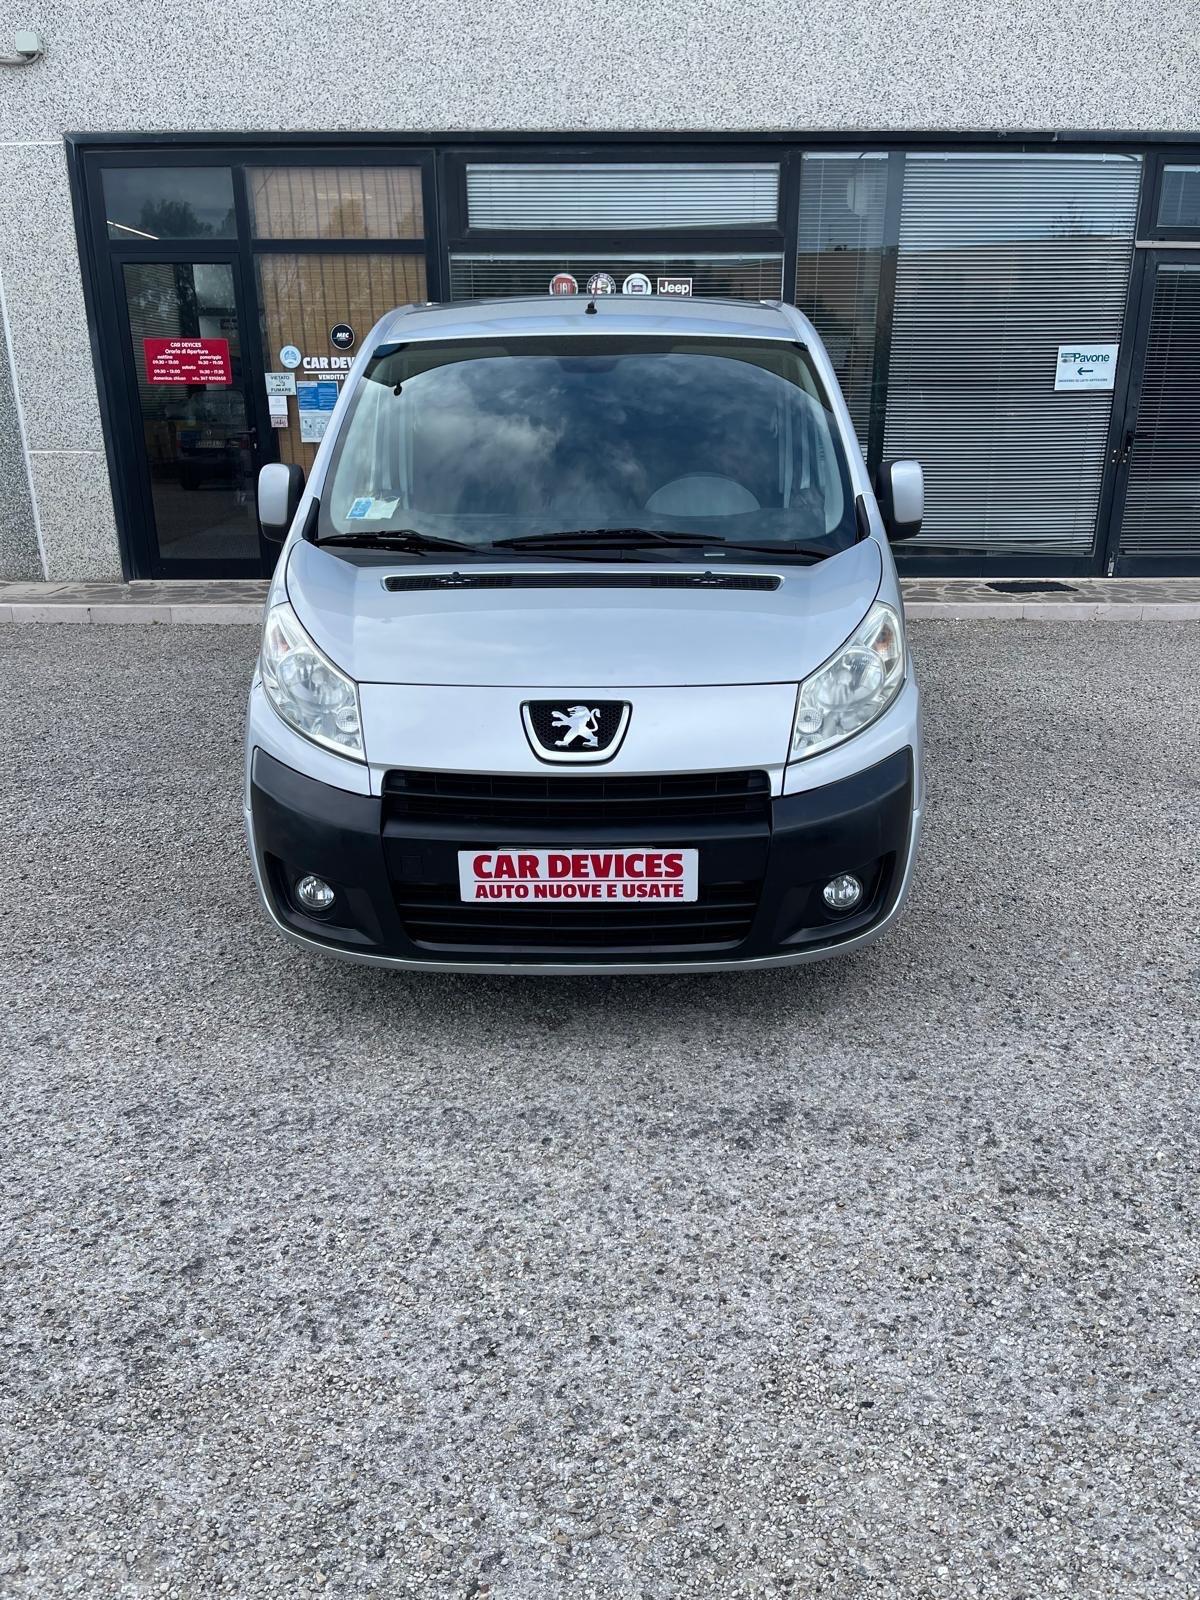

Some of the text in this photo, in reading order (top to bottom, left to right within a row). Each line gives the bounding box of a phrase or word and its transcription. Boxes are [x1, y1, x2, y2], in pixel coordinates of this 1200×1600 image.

[660, 281, 690, 295] Jeep
[302, 356, 329, 369] CAR
[1073, 352, 1110, 363] Pavone
[473, 853, 684, 879] CAR DEVICES
[475, 884, 684, 899] AUTO NUOVE E USATE
